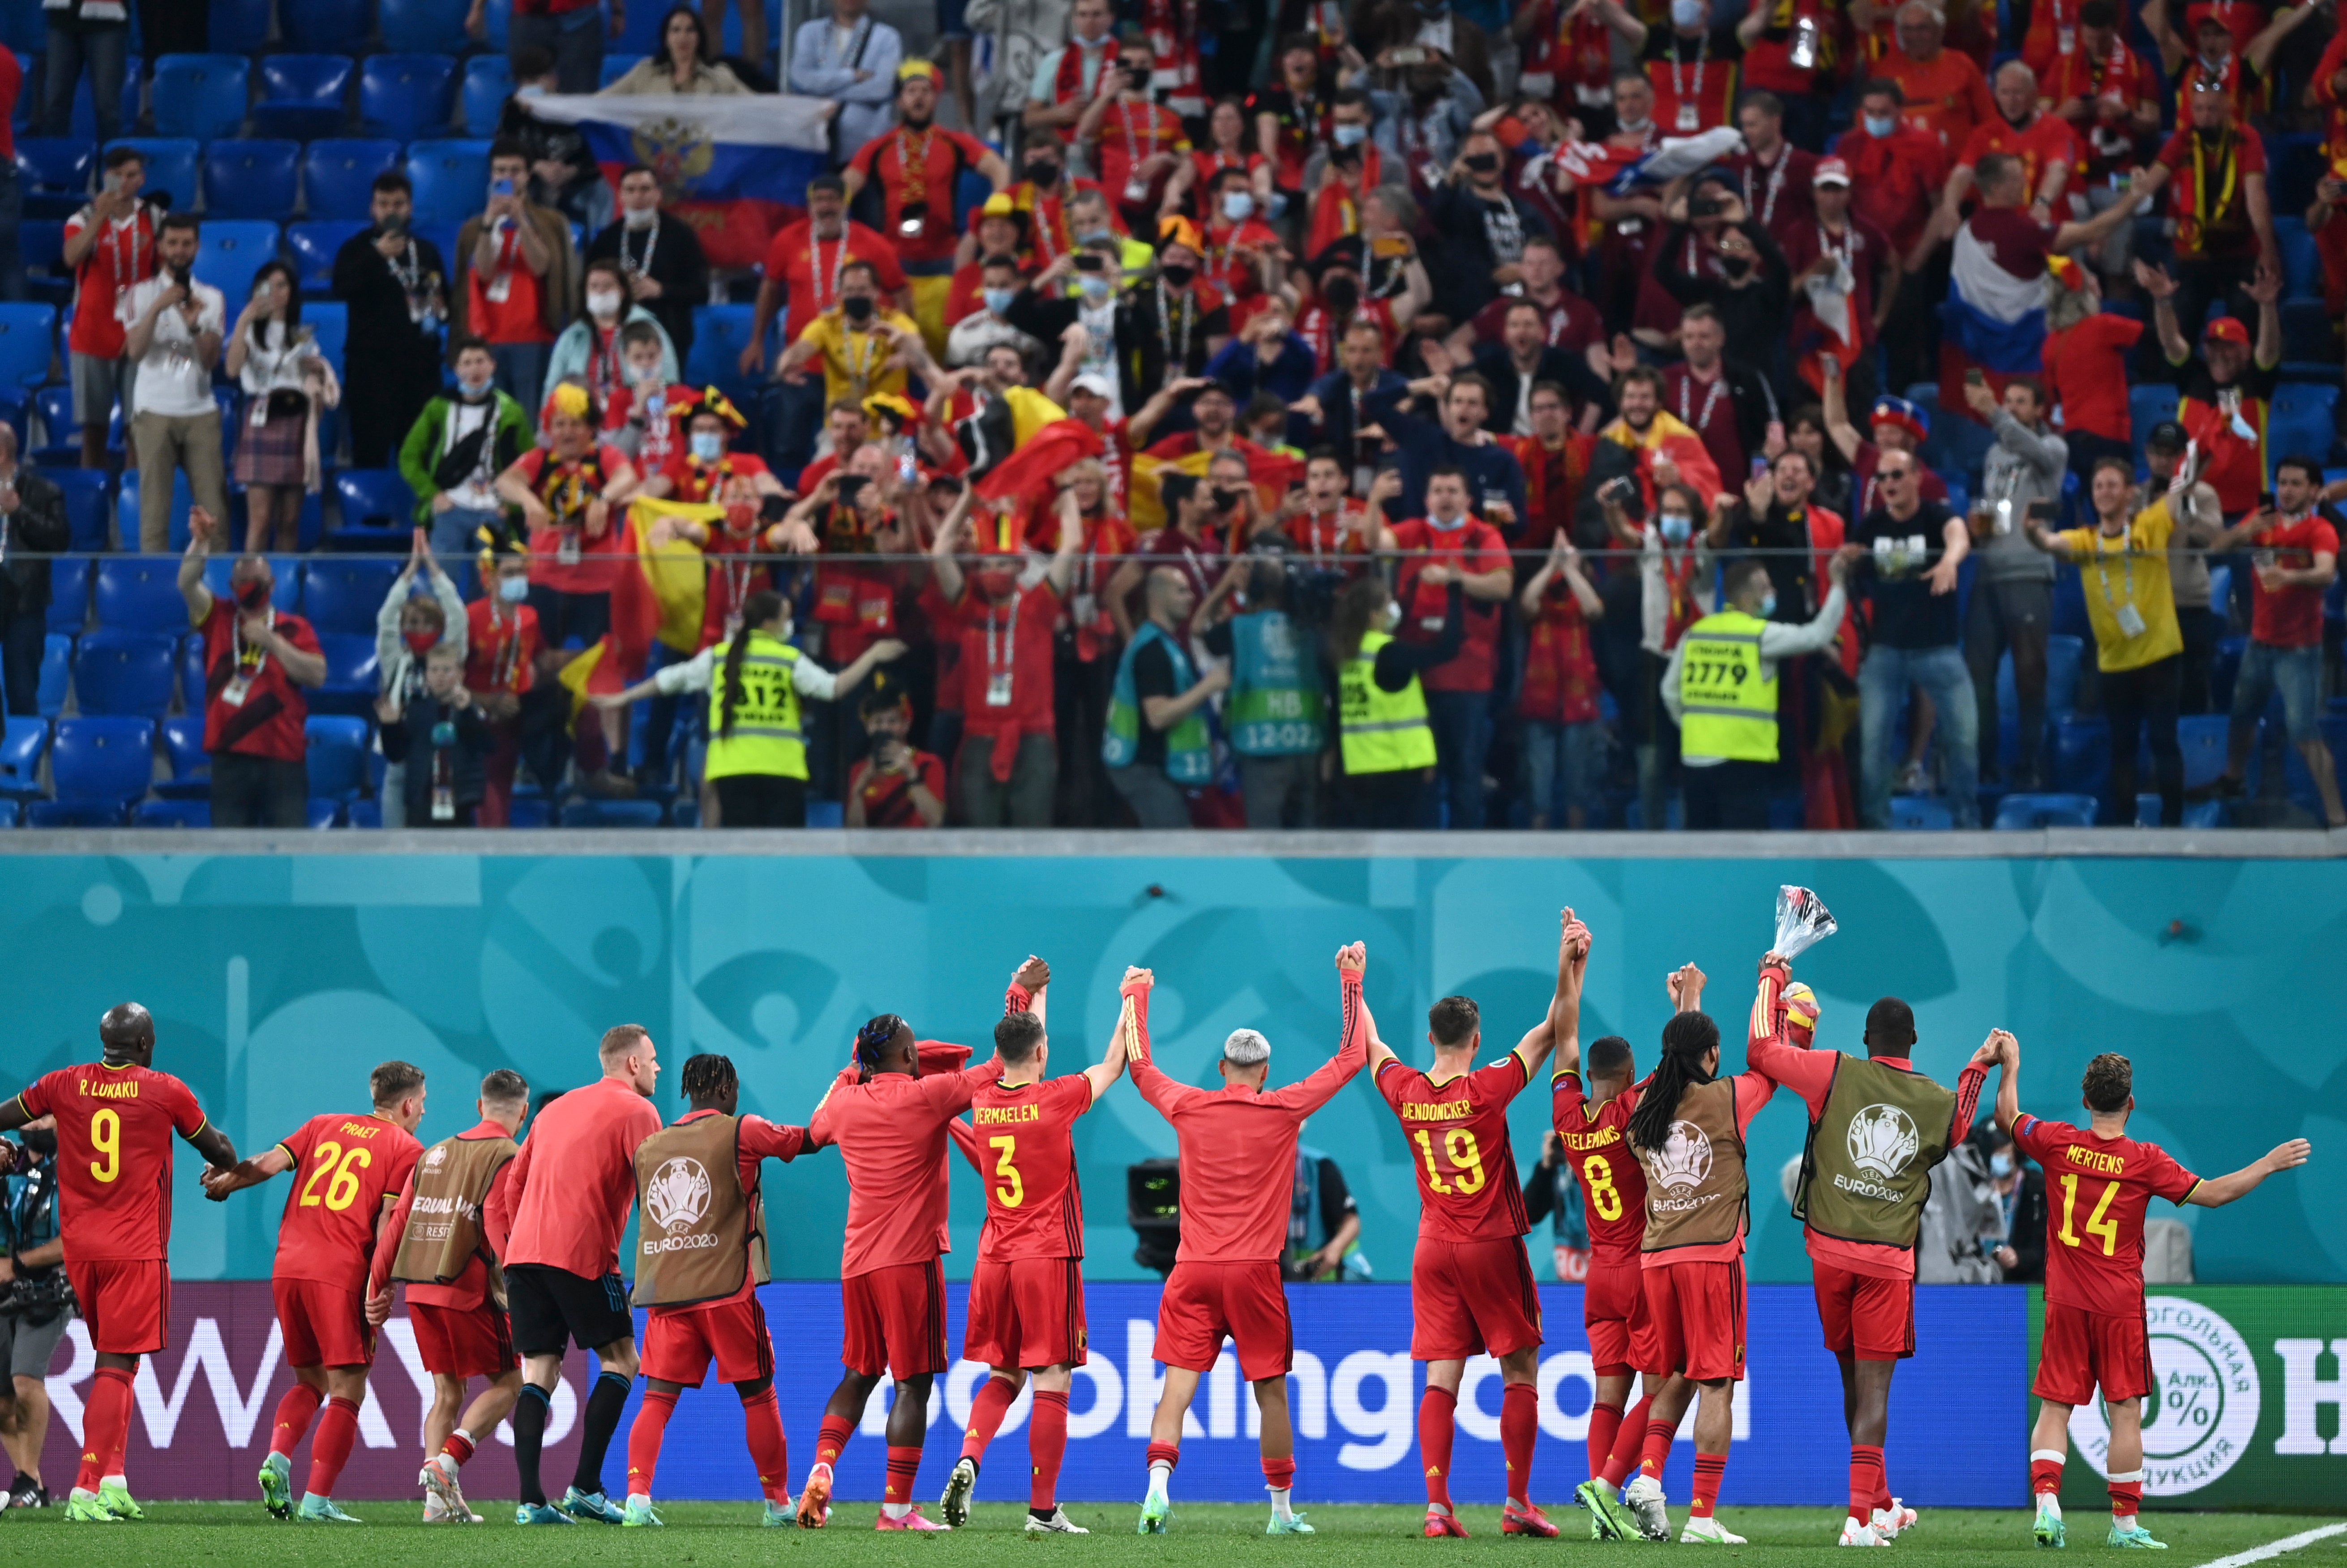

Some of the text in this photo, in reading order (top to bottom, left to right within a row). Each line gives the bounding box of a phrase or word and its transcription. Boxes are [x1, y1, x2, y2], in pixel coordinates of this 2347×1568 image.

[1687, 662, 1748, 685] 2779
[79, 1079, 138, 1098] R. LUKAKU
[975, 1103, 1039, 1124] VERMAELEN
[1402, 1100, 1473, 1121] DENDONCKER
[339, 1121, 381, 1139] PRAET
[1559, 1125, 1621, 1151] TIELEMANS
[90, 1108, 120, 1182] 9
[1413, 1128, 1485, 1195] 19
[2066, 1144, 2124, 1174] MERTENS
[299, 1141, 372, 1211] 26
[989, 1135, 1024, 1208] 3
[1583, 1154, 1623, 1221] 8
[1670, 1187, 1692, 1196] UEFA
[1833, 1174, 1904, 1203] EURO2020
[411, 1196, 453, 1215] EQUAL
[2057, 1173, 2120, 1256] 14
[666, 1224, 689, 1235] UEFA
[643, 1233, 718, 1255] EURO2020
